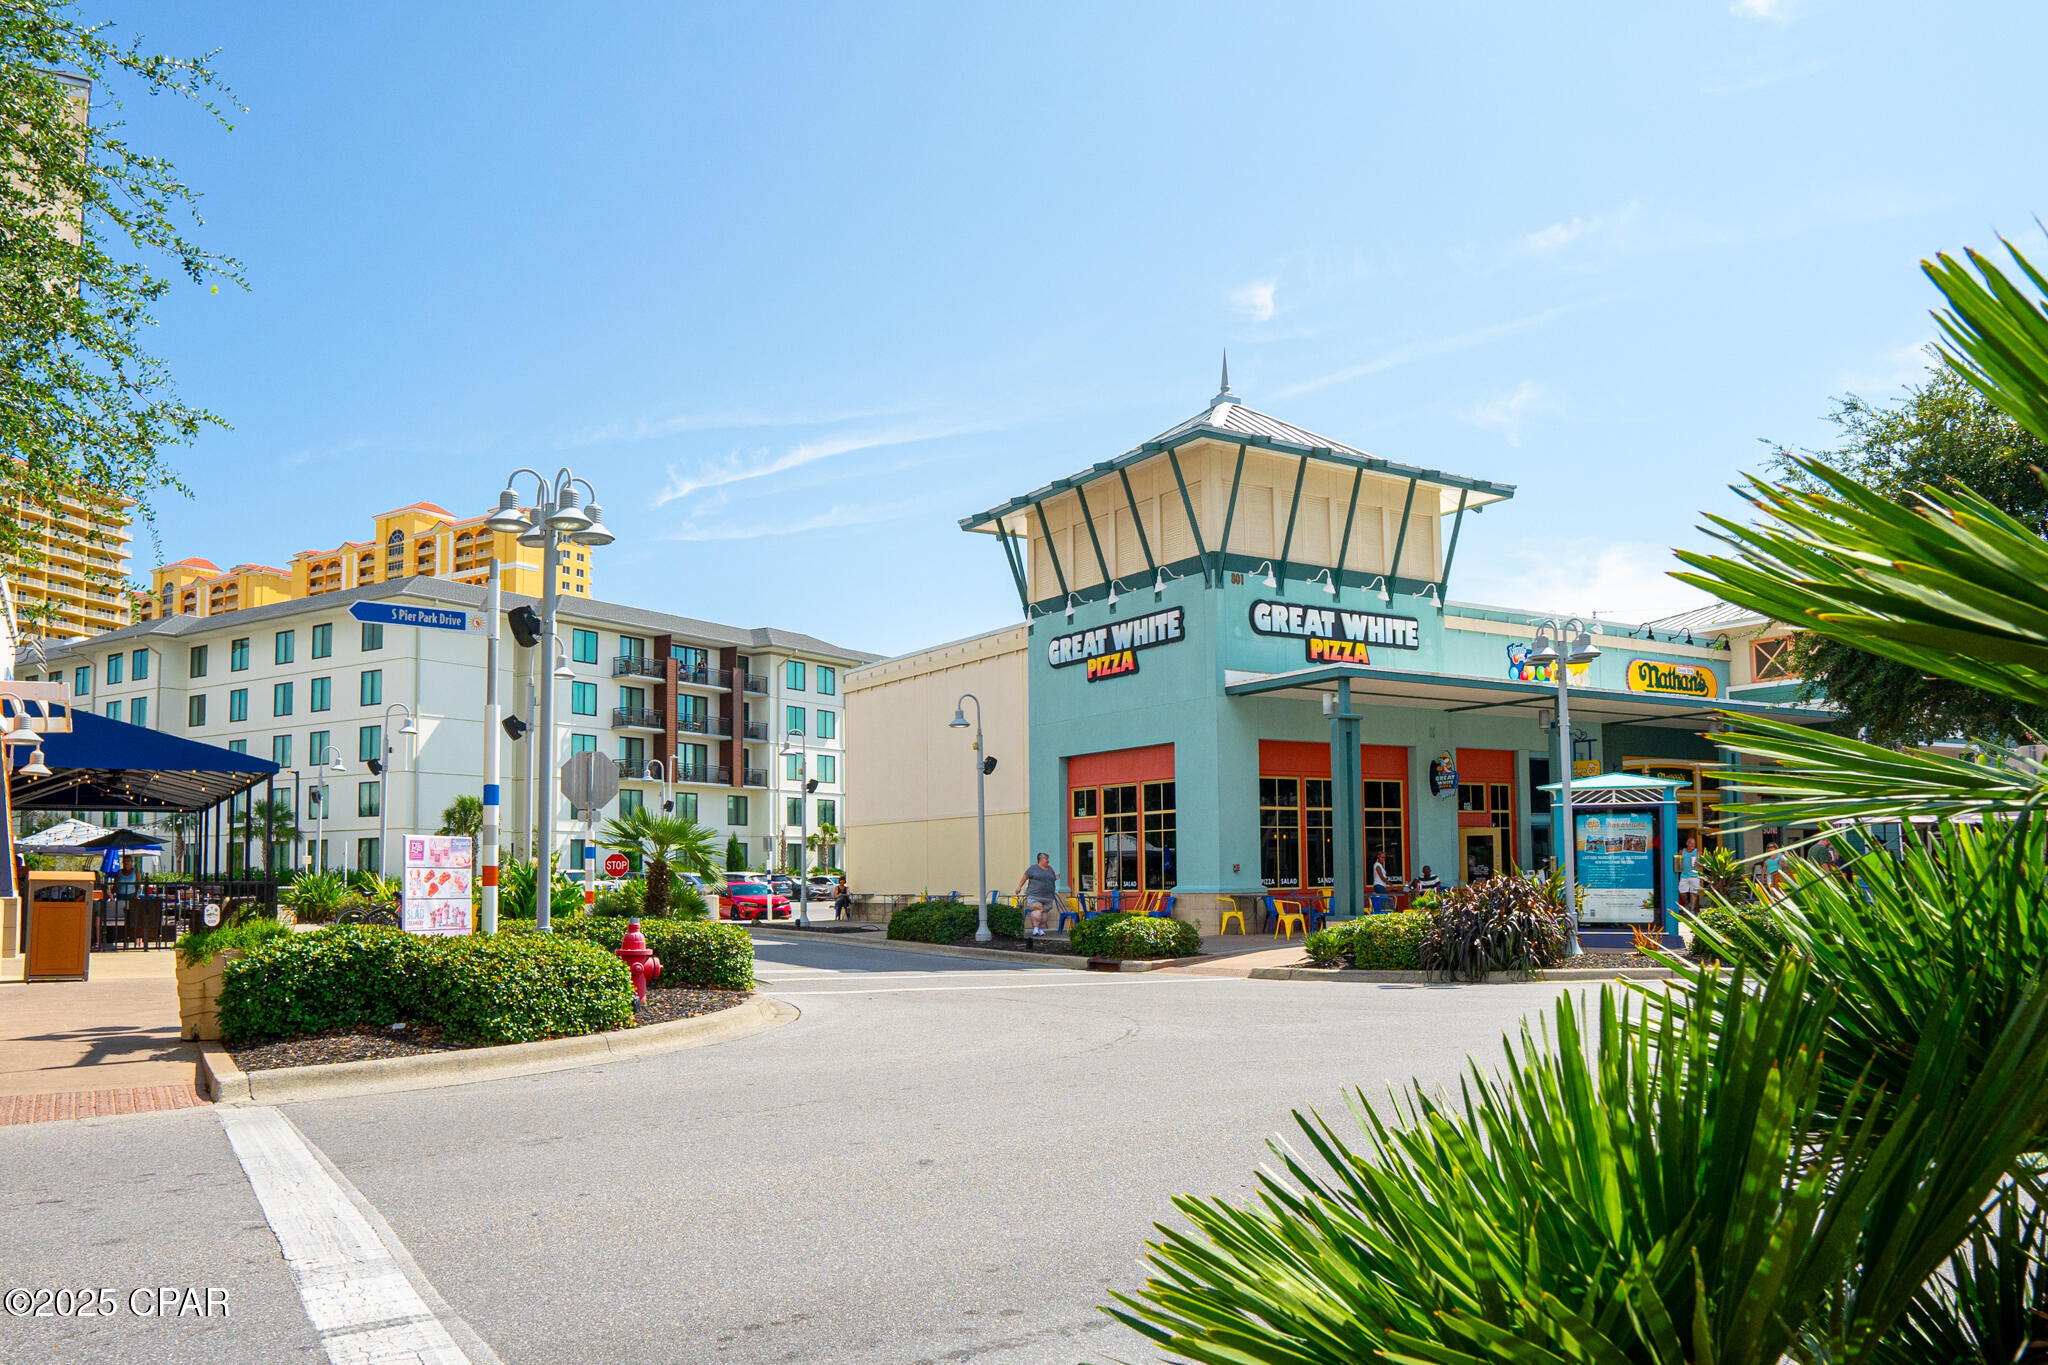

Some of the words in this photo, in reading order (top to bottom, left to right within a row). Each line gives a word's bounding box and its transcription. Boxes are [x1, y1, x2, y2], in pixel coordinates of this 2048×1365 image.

[1231, 573, 1244, 585] 801
[391, 608, 397, 620] S
[399, 608, 417, 622] Pier
[418, 611, 438, 624] Park
[439, 613, 462, 626] Drive
[1253, 602, 1335, 638] GREAT
[1341, 612, 1418, 647] WHITE
[1048, 628, 1108, 666] GREAT
[1111, 609, 1181, 651] WHITE
[1309, 638, 1370, 665] PIZZA
[1087, 650, 1136, 679] PIZZA
[1638, 662, 1709, 696] Nathan's
[1435, 774, 1455, 782] GREAT
[606, 860, 627, 870] STOP
[1123, 880, 1137, 888] SALAD
[1280, 877, 1298, 885] SALAD
